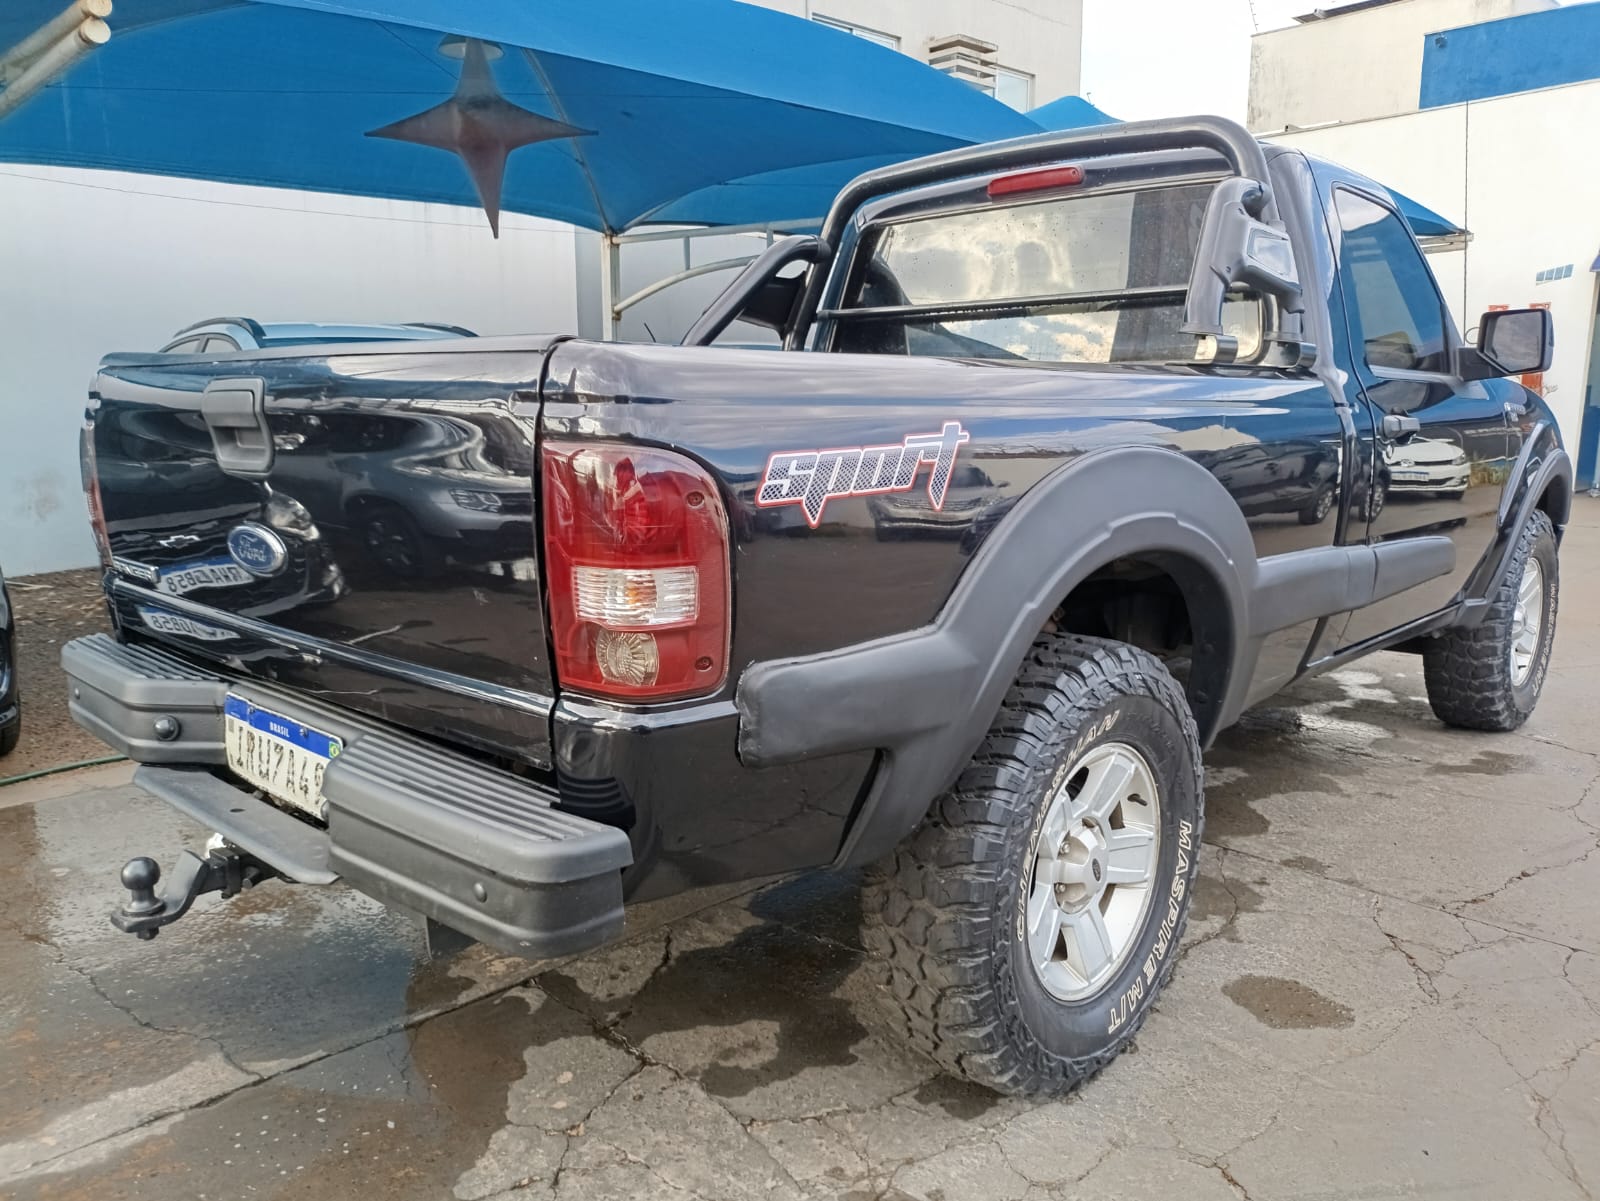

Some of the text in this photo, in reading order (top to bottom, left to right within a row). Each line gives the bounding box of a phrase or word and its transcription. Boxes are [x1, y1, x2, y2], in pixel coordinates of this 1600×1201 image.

[239, 534, 267, 562] Ford
[269, 721, 290, 738] BRASIL
[1108, 817, 1192, 1035] MASPIRE M/T
